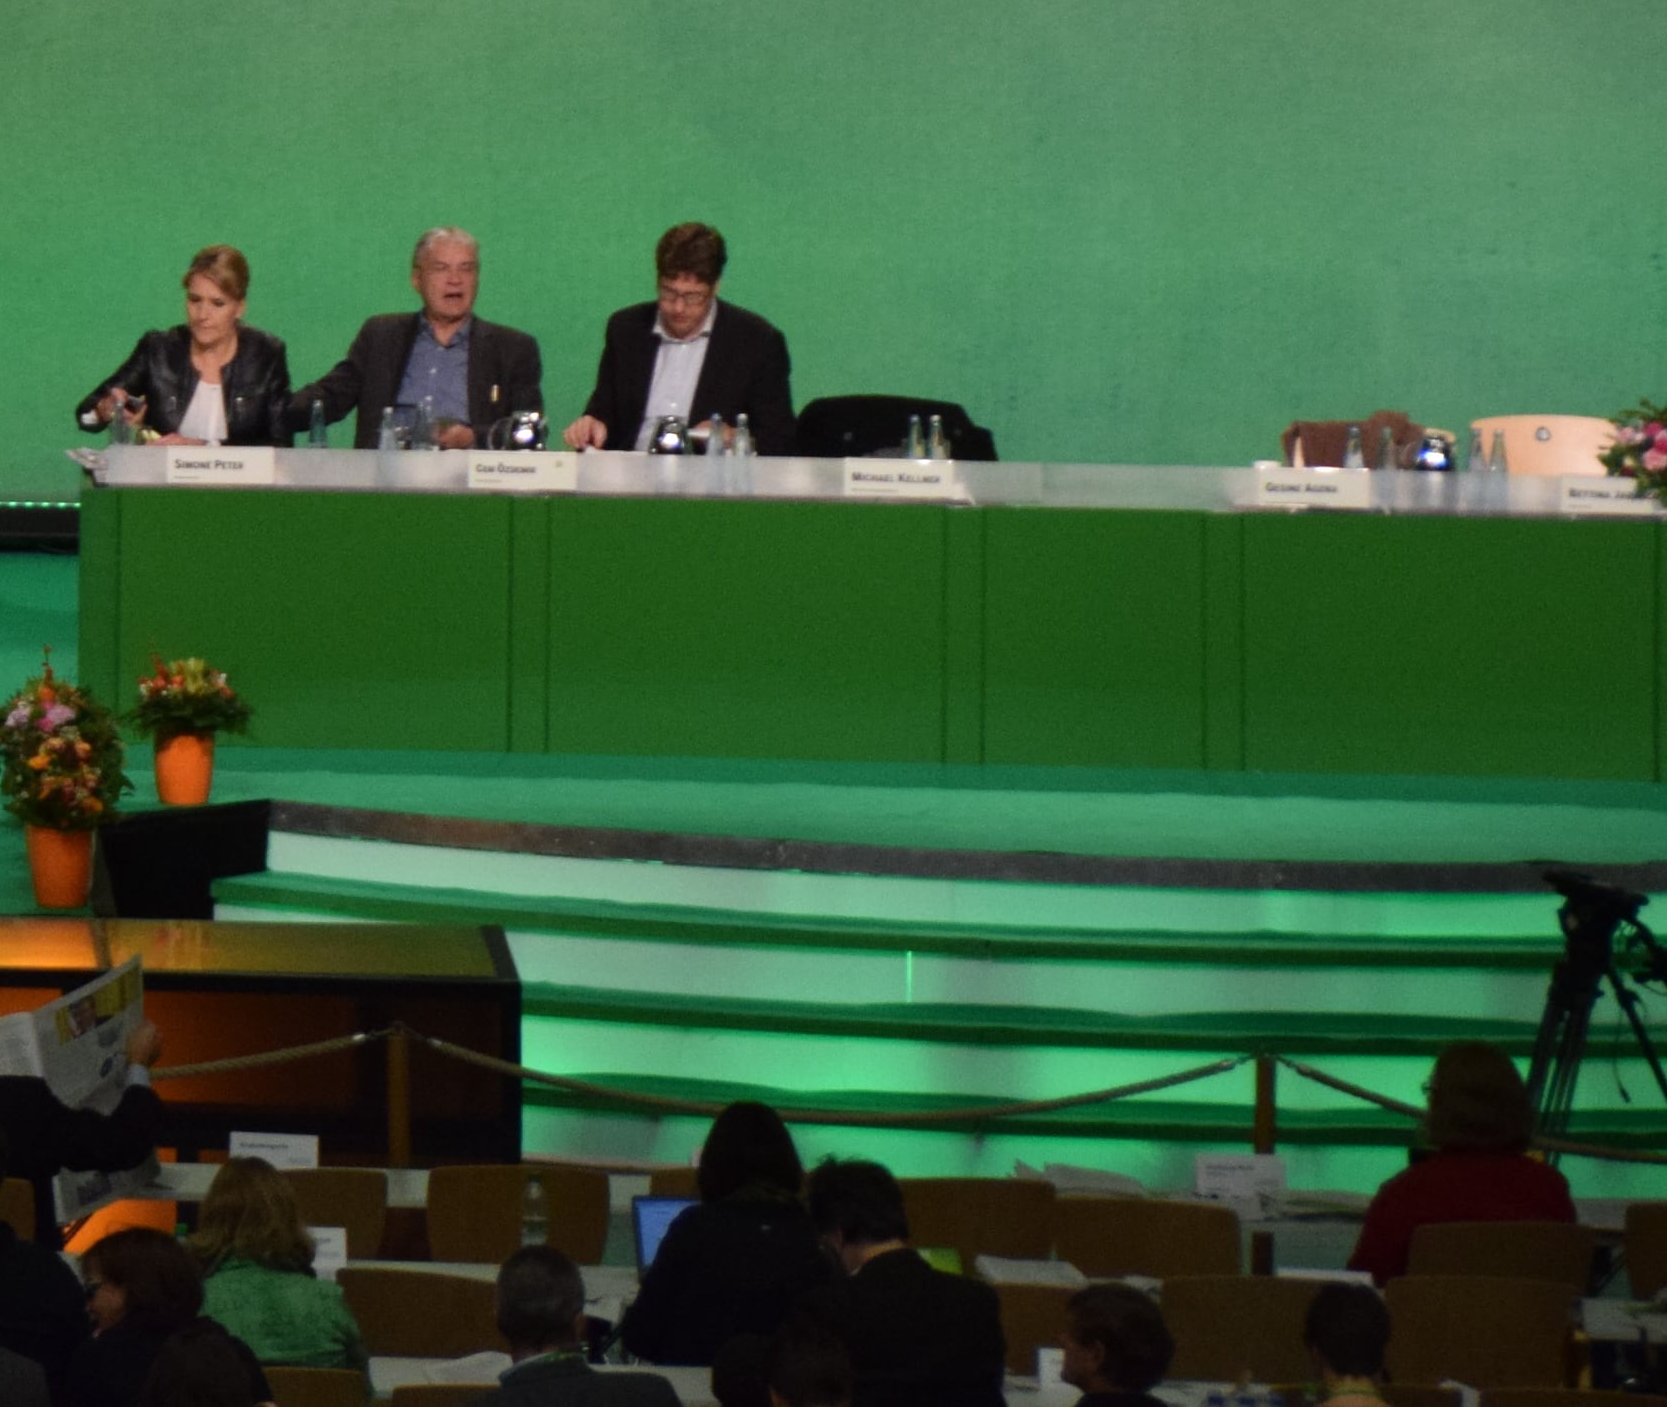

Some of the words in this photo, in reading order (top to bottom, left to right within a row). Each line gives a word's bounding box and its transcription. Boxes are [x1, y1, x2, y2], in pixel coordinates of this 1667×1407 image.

[174, 458, 211, 470] SIMONE
[214, 459, 244, 471] PETER
[851, 471, 895, 483] MICHAEL
[898, 472, 941, 484] KELLNER
